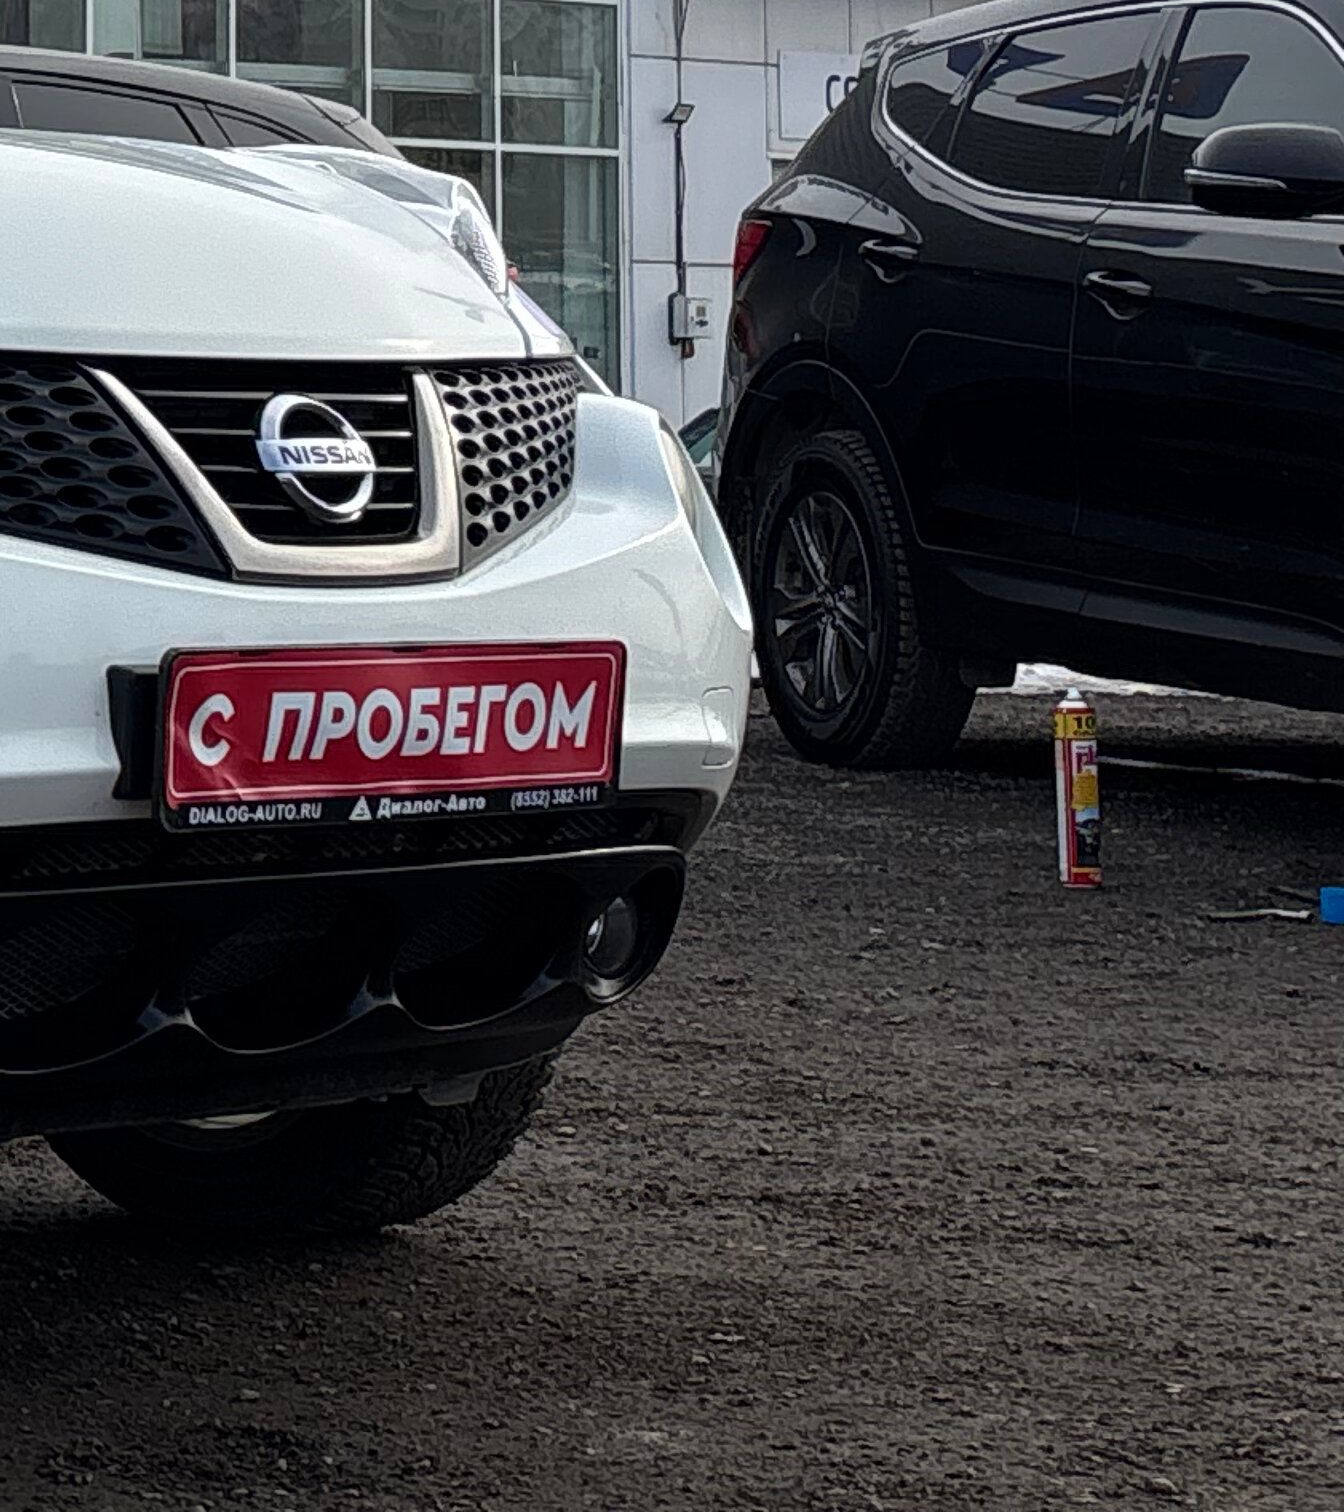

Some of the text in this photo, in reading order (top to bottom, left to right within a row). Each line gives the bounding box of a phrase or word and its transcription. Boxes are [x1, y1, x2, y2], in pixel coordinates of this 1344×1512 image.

[279, 444, 371, 465] NISSAN
[188, 682, 598, 767] С ПРОБЕГОМ
[189, 802, 322, 825] DIALOG-AUTO.RU
[376, 794, 486, 819] Диалог-Авто
